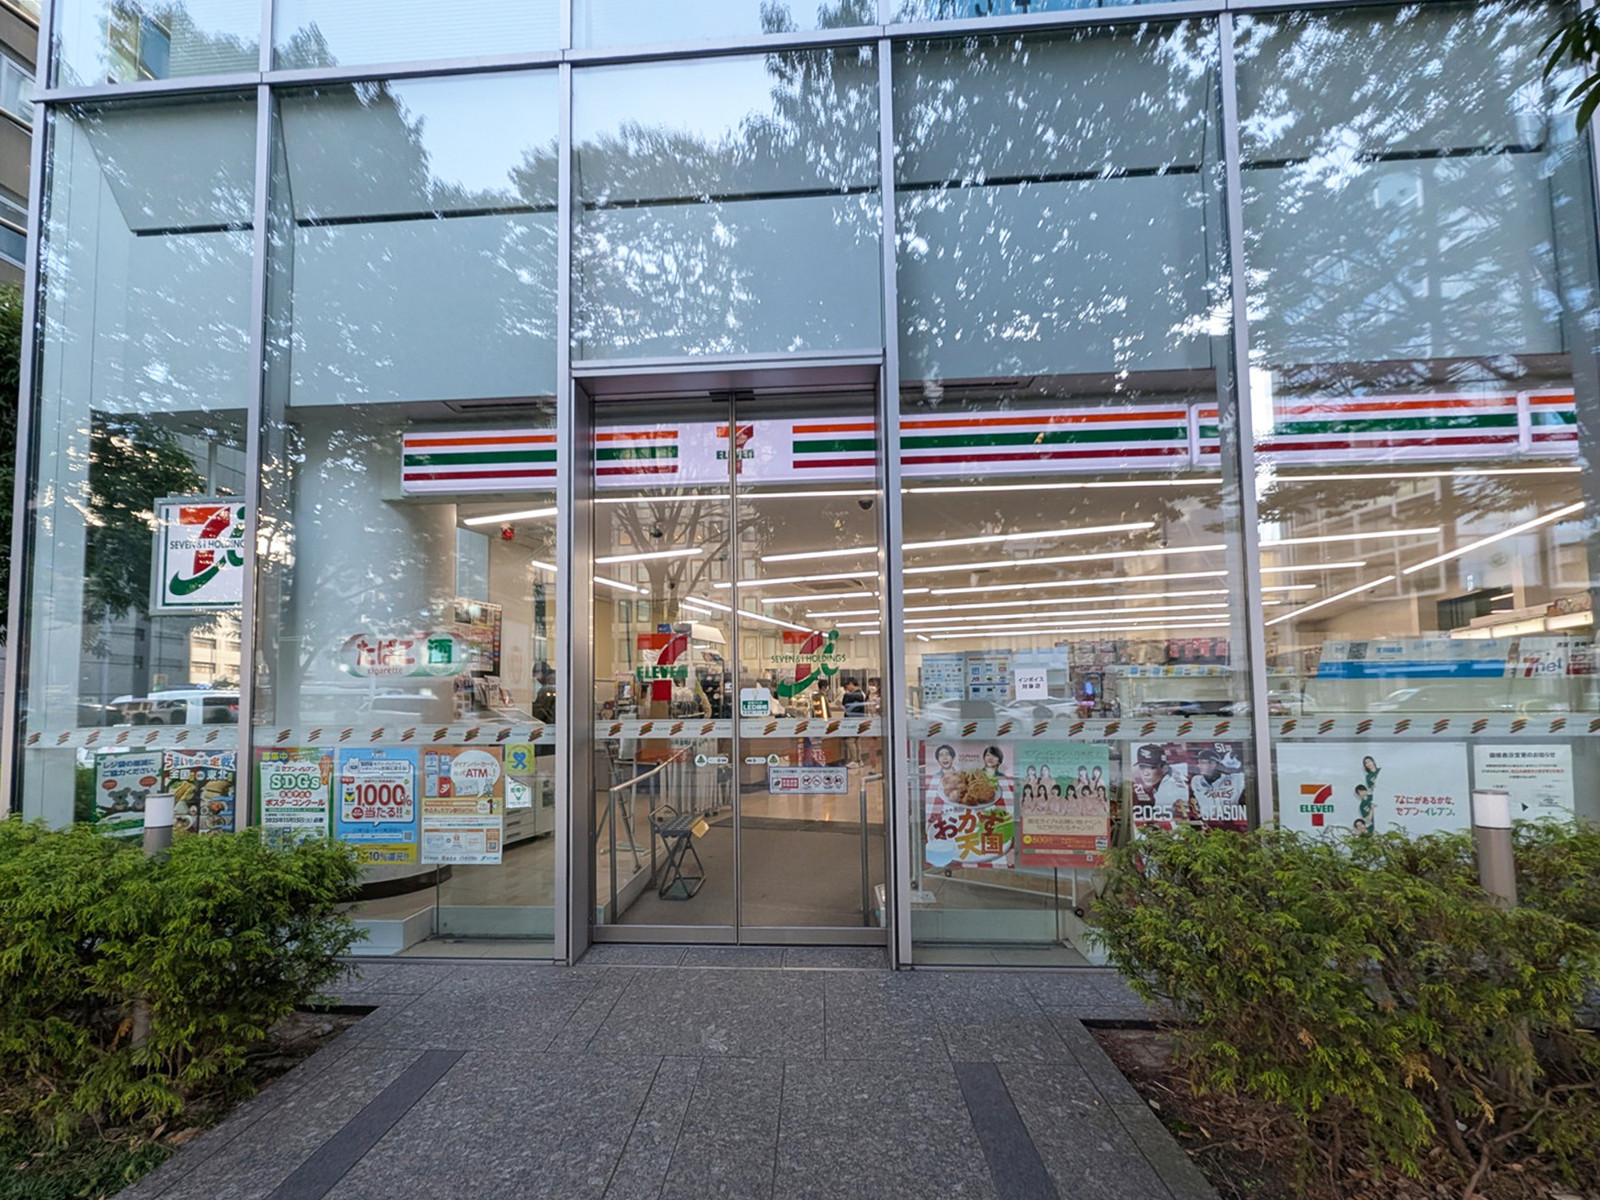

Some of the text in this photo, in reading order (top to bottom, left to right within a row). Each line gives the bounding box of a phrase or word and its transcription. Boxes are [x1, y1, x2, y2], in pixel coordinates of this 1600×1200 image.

[357, 639, 415, 666] たばこ
[428, 638, 453, 665] 酒
[771, 655, 795, 664] SEVEN
[805, 653, 847, 663] HOLDINGS
[367, 666, 404, 675] cigarette
[465, 768, 489, 778] ATM
[269, 773, 321, 791] SDGs
[265, 799, 326, 807] ポスターコンクール
[1132, 805, 1173, 821] 2025
[954, 832, 1005, 860] 天国
